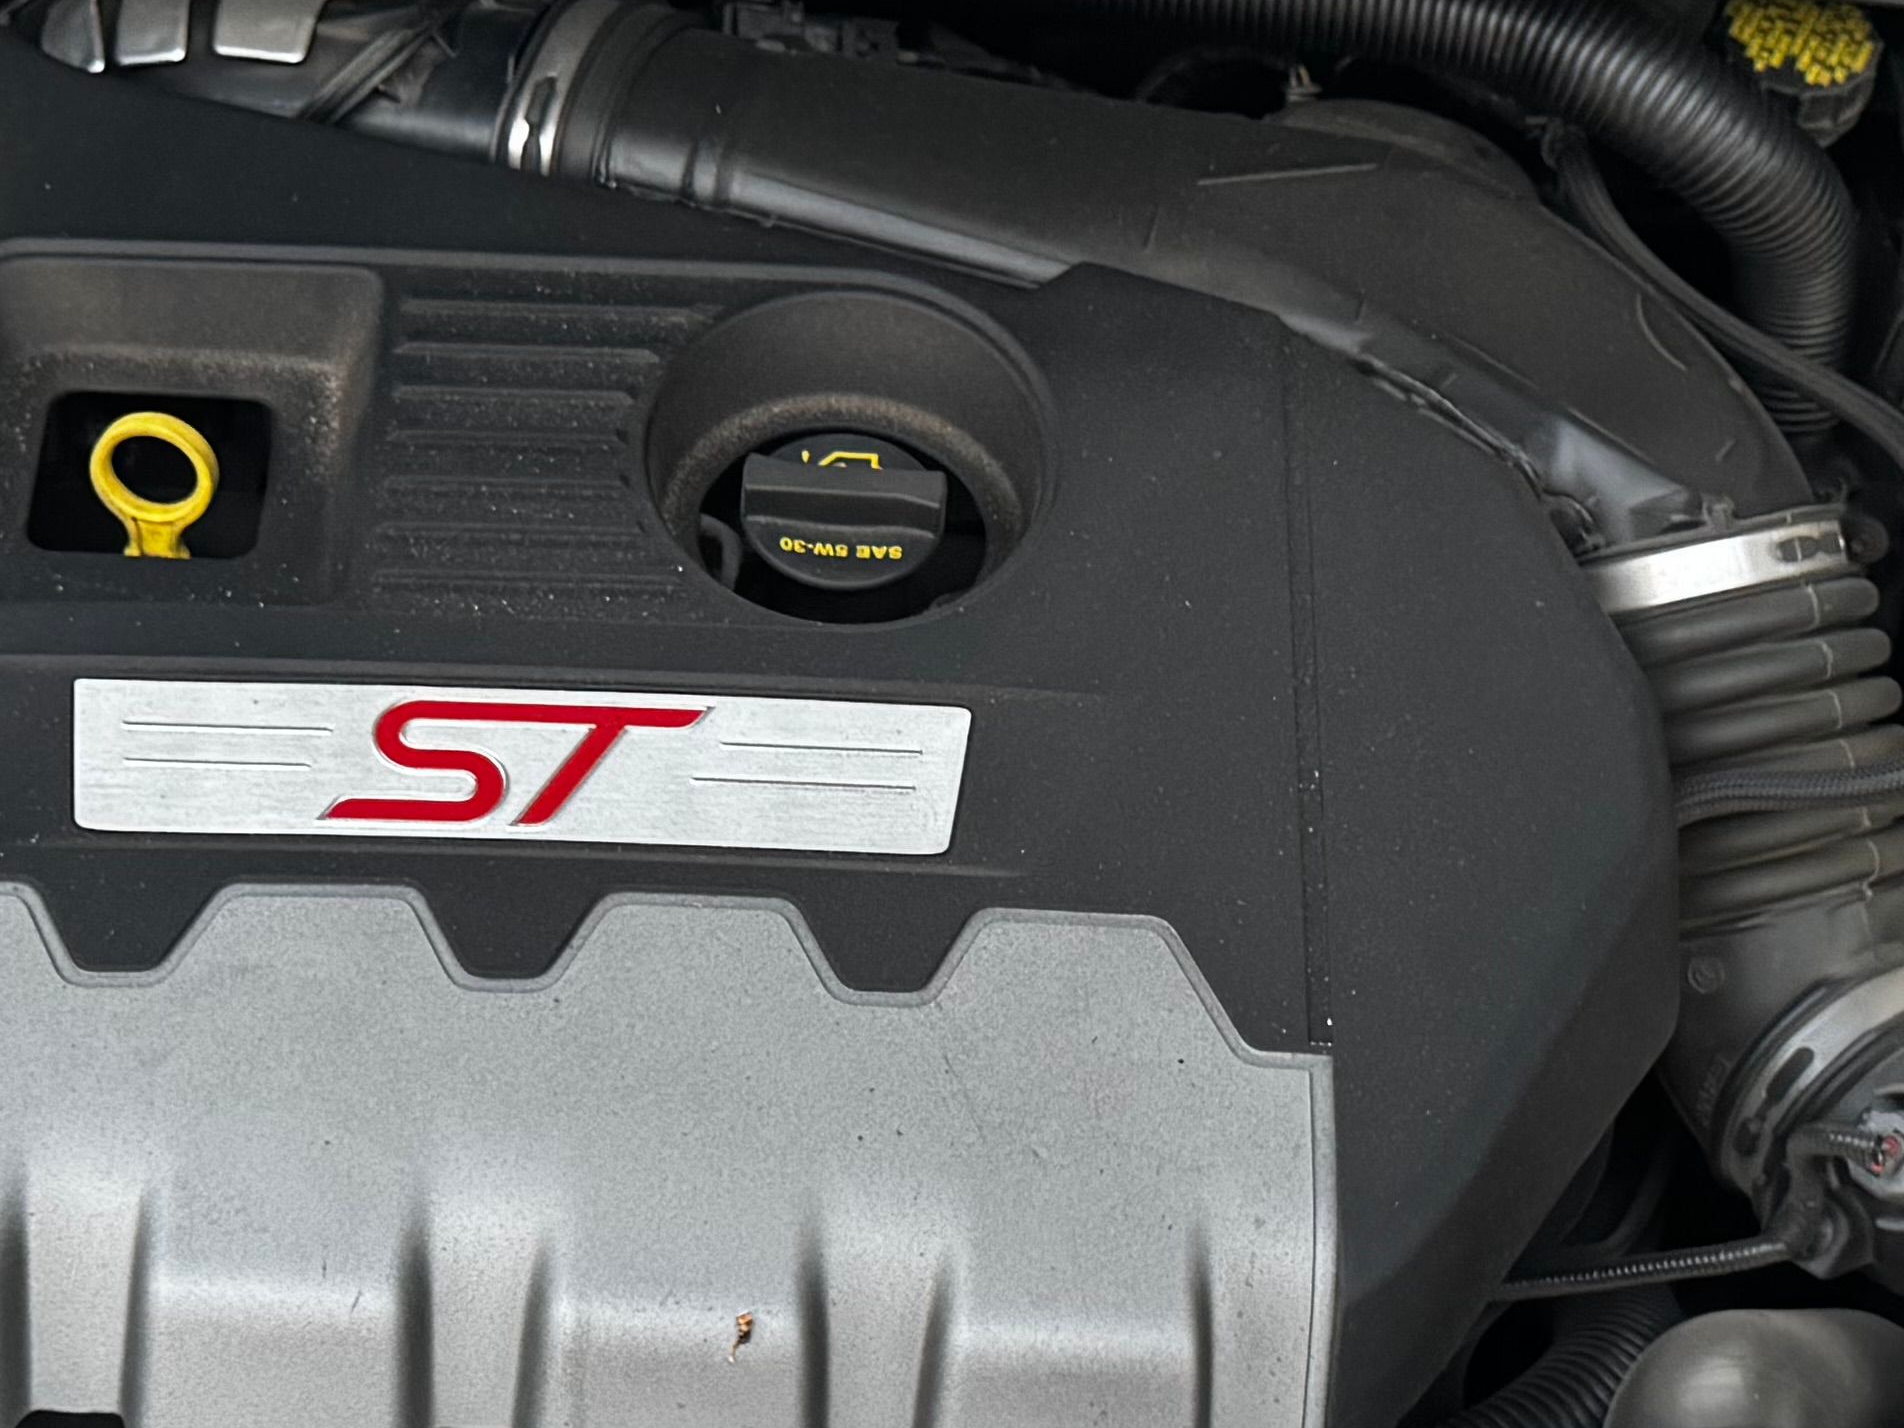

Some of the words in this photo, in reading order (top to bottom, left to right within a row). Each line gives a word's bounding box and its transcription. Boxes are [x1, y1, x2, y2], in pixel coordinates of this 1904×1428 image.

[779, 536, 849, 558] 5W-30
[855, 544, 903, 560] SAE
[320, 699, 712, 827] ST
